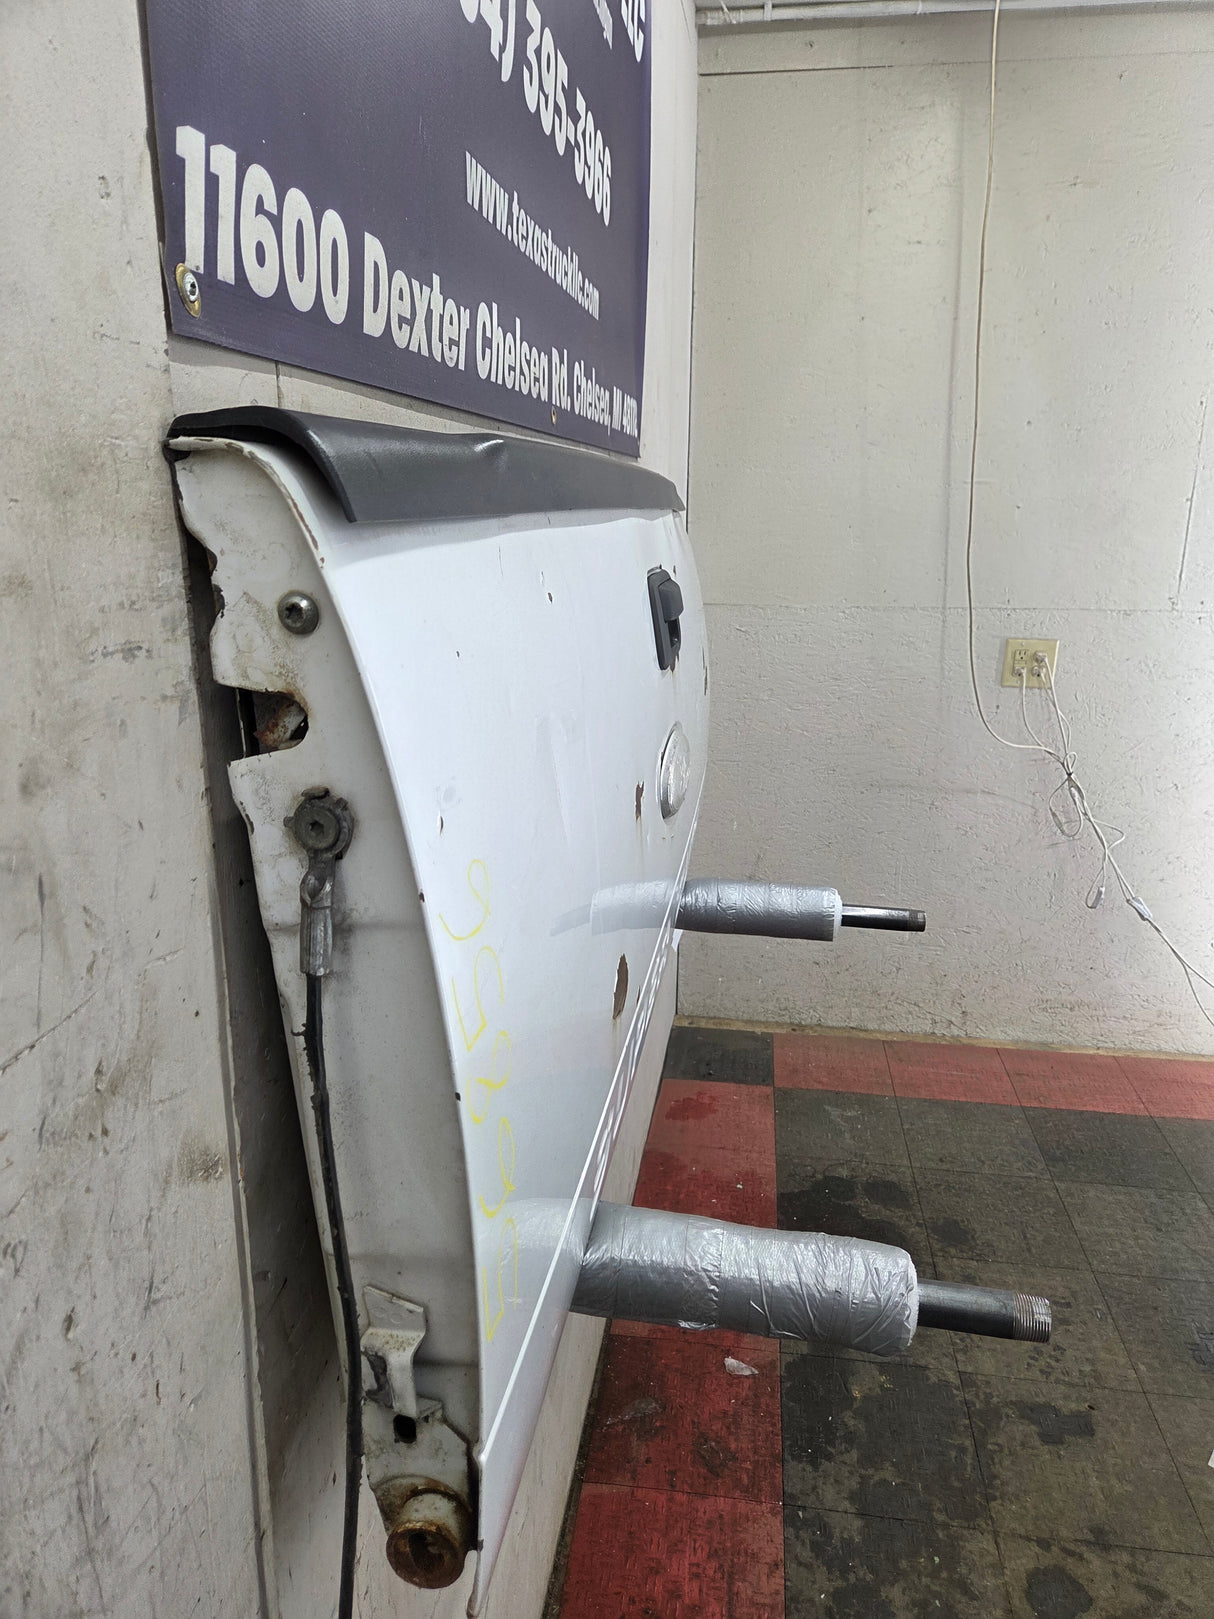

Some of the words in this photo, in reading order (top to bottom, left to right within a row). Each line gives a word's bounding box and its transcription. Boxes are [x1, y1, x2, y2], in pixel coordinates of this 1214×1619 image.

[523, 0, 612, 226] 395-3966
[175, 125, 349, 325] 11600
[363, 231, 470, 371] Dexter
[476, 301, 549, 403] Chelsea
[551, 346, 571, 412] Rd.
[573, 359, 612, 436] Chelsea,
[612, 386, 622, 431] MI
[465, 150, 600, 321] www.texastruckllc.com
